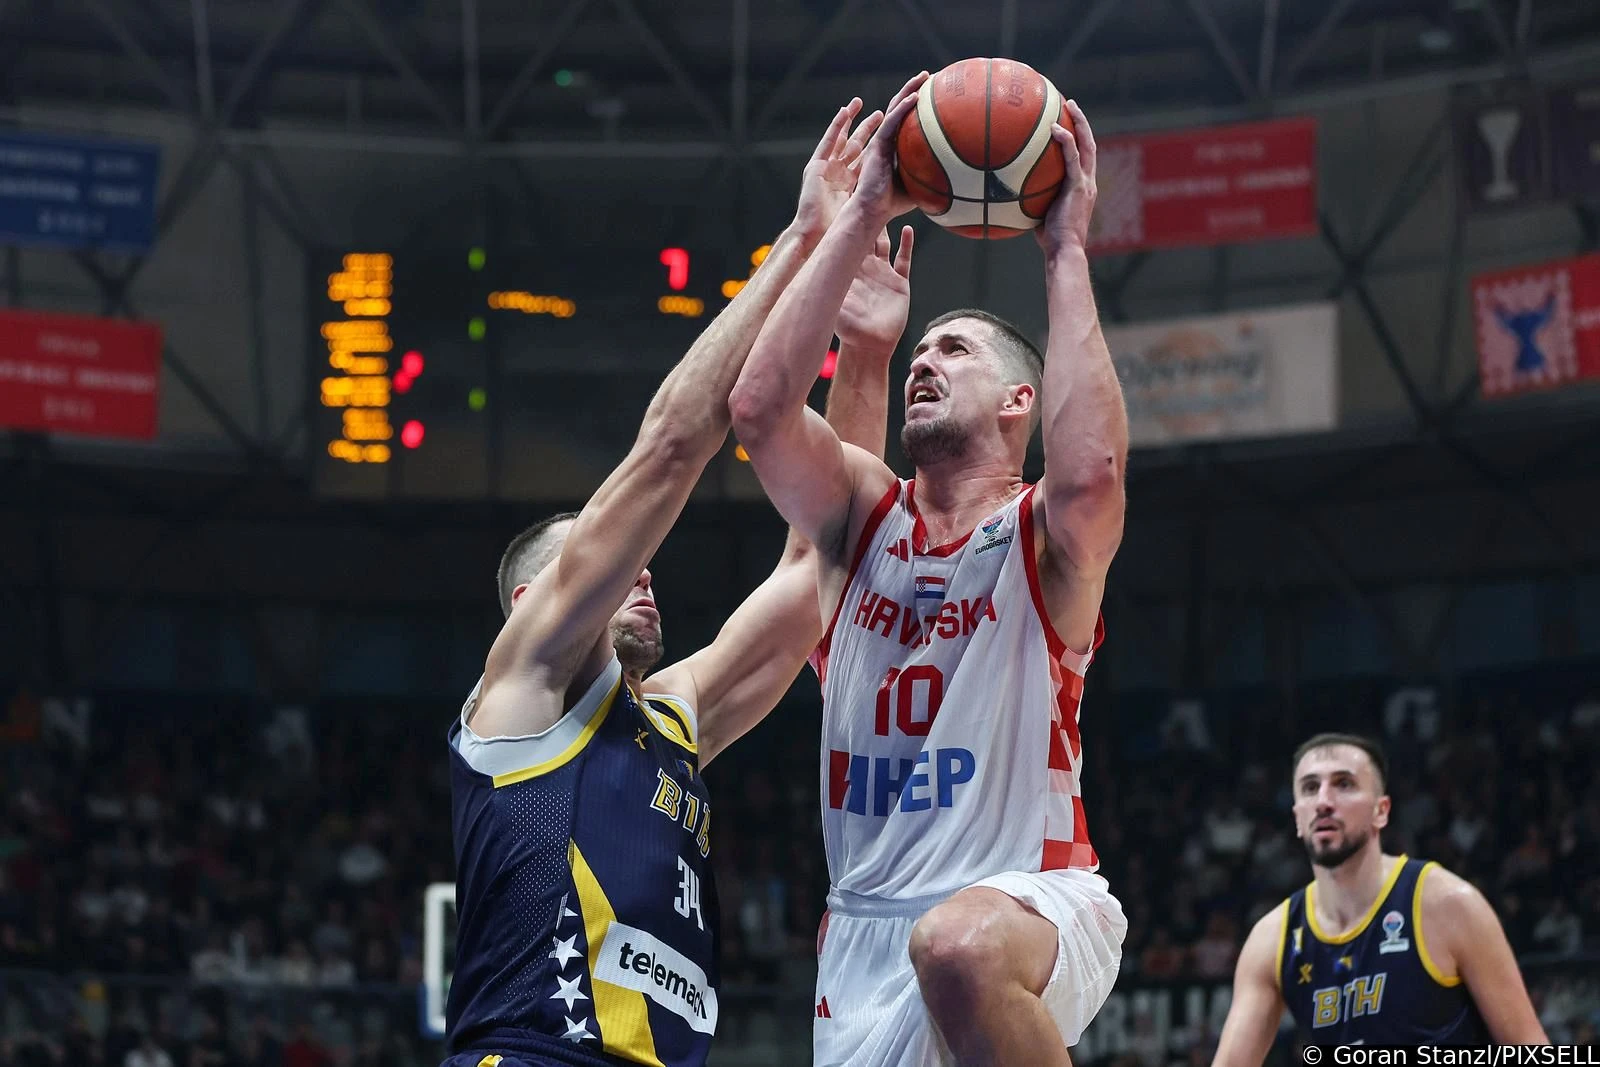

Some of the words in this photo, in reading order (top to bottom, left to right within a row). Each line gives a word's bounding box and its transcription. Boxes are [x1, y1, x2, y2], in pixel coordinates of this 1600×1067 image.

[975, 536, 1012, 555] EUROBASKET
[875, 664, 944, 737] 10
[873, 747, 976, 817] HEP
[674, 855, 705, 932] 34
